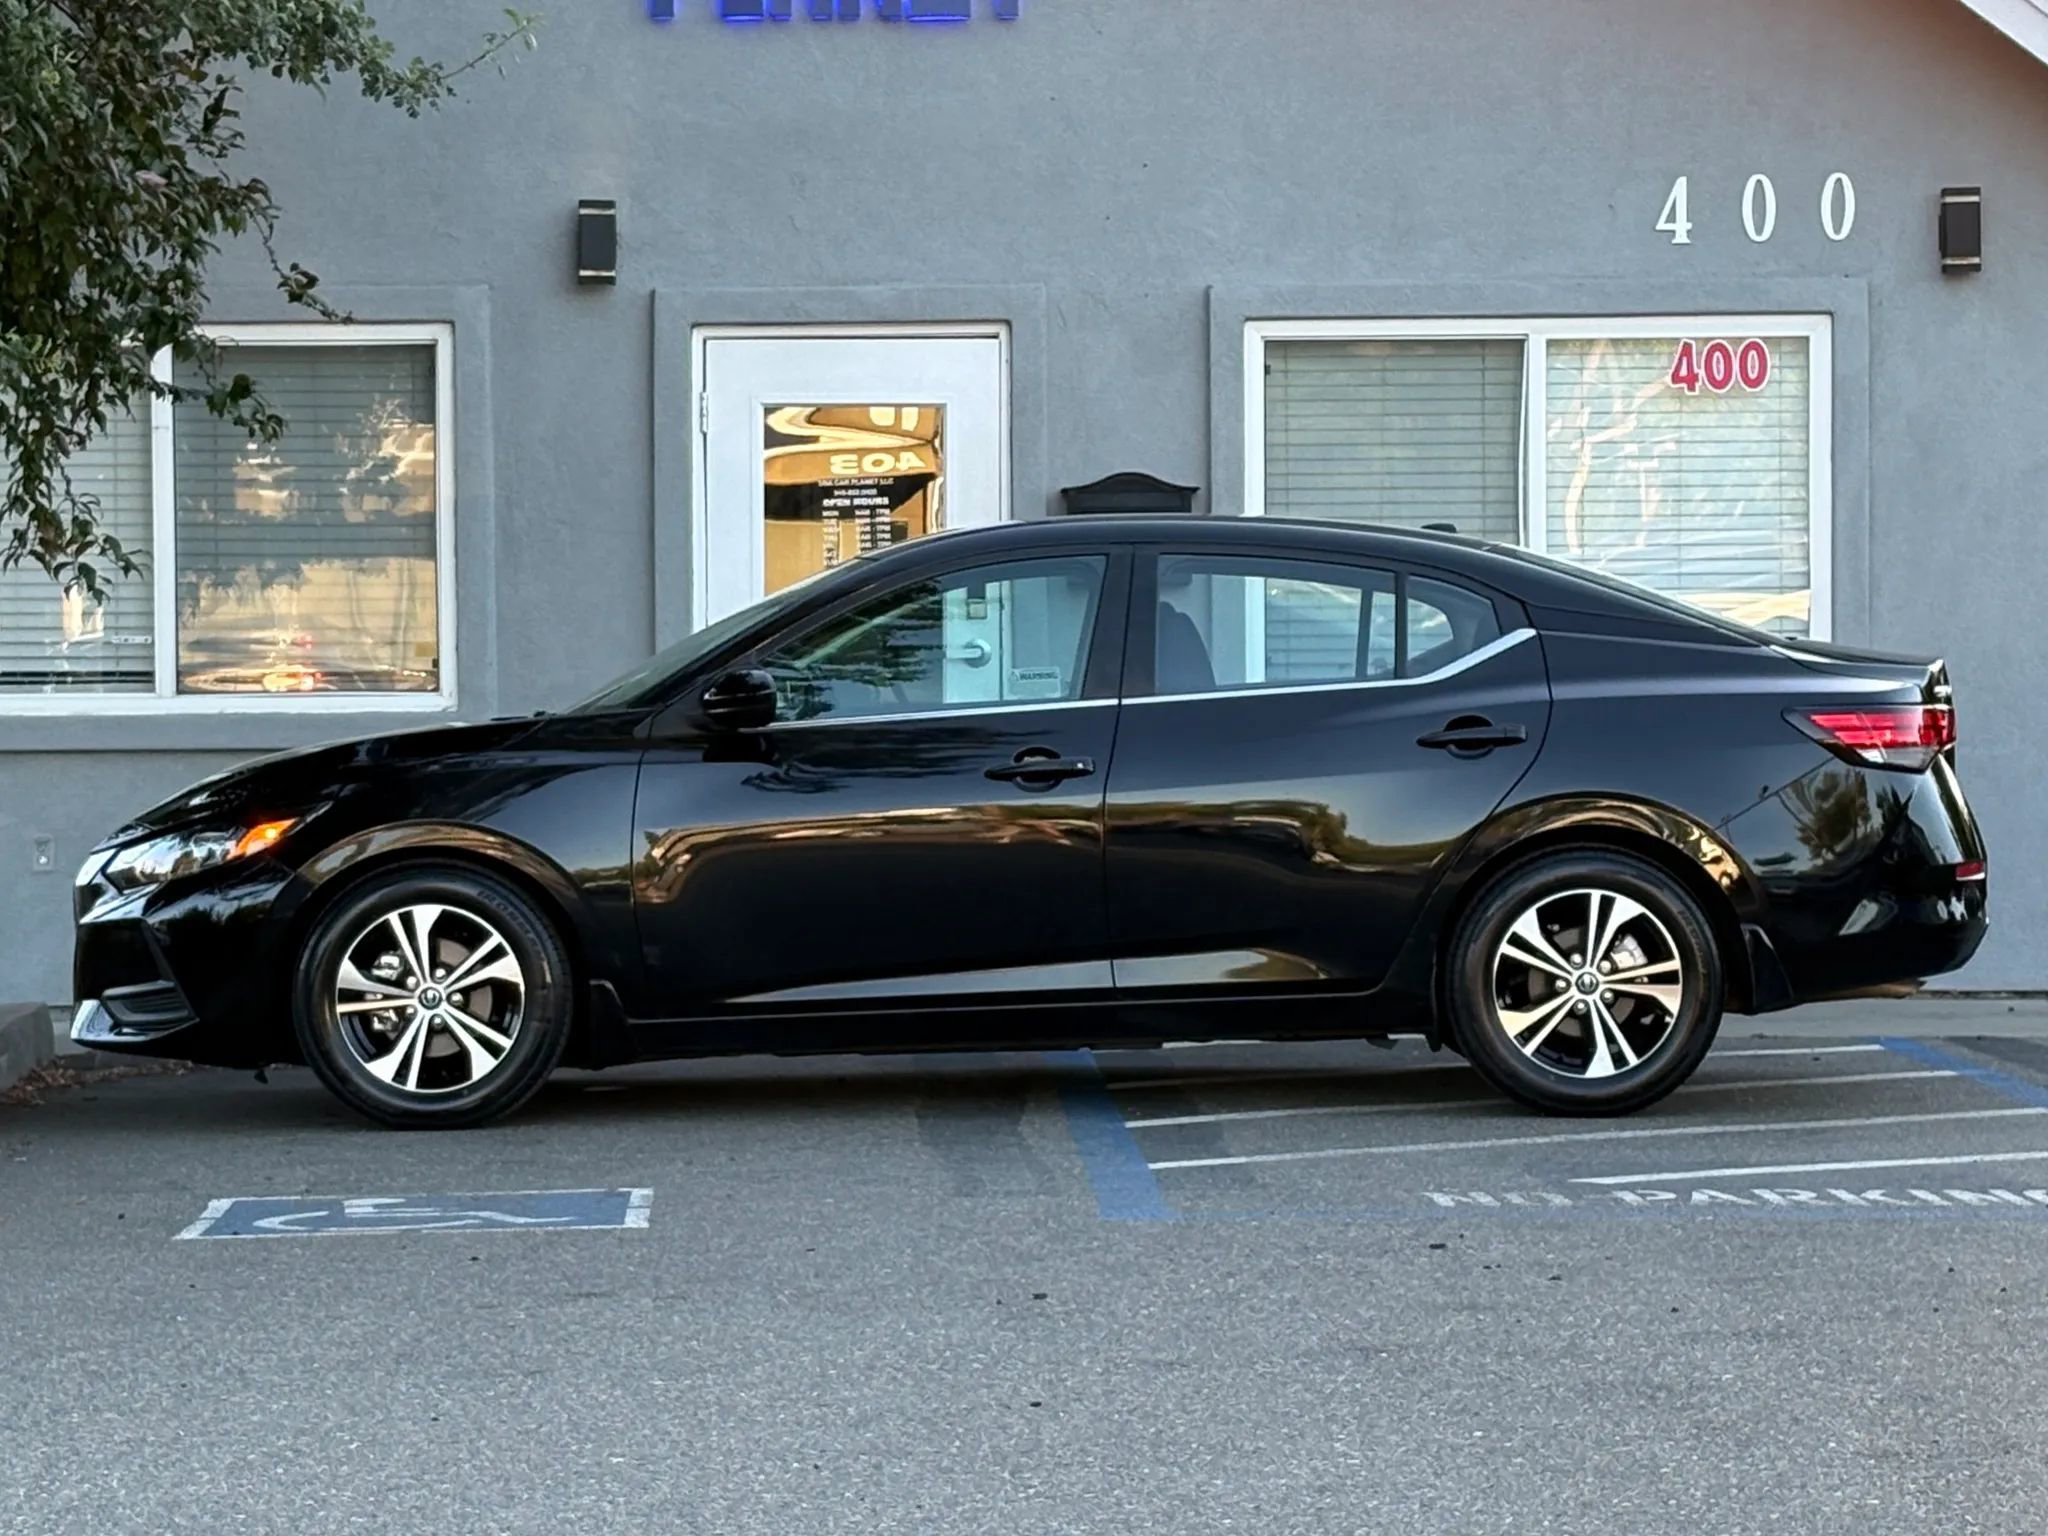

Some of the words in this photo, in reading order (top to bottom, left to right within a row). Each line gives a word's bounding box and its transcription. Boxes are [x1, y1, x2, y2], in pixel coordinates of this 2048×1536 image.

[1655, 172, 1856, 244] 400
[1670, 338, 1771, 395] 400
[823, 499, 851, 507] OPEN
[853, 497, 889, 506] HOURS
